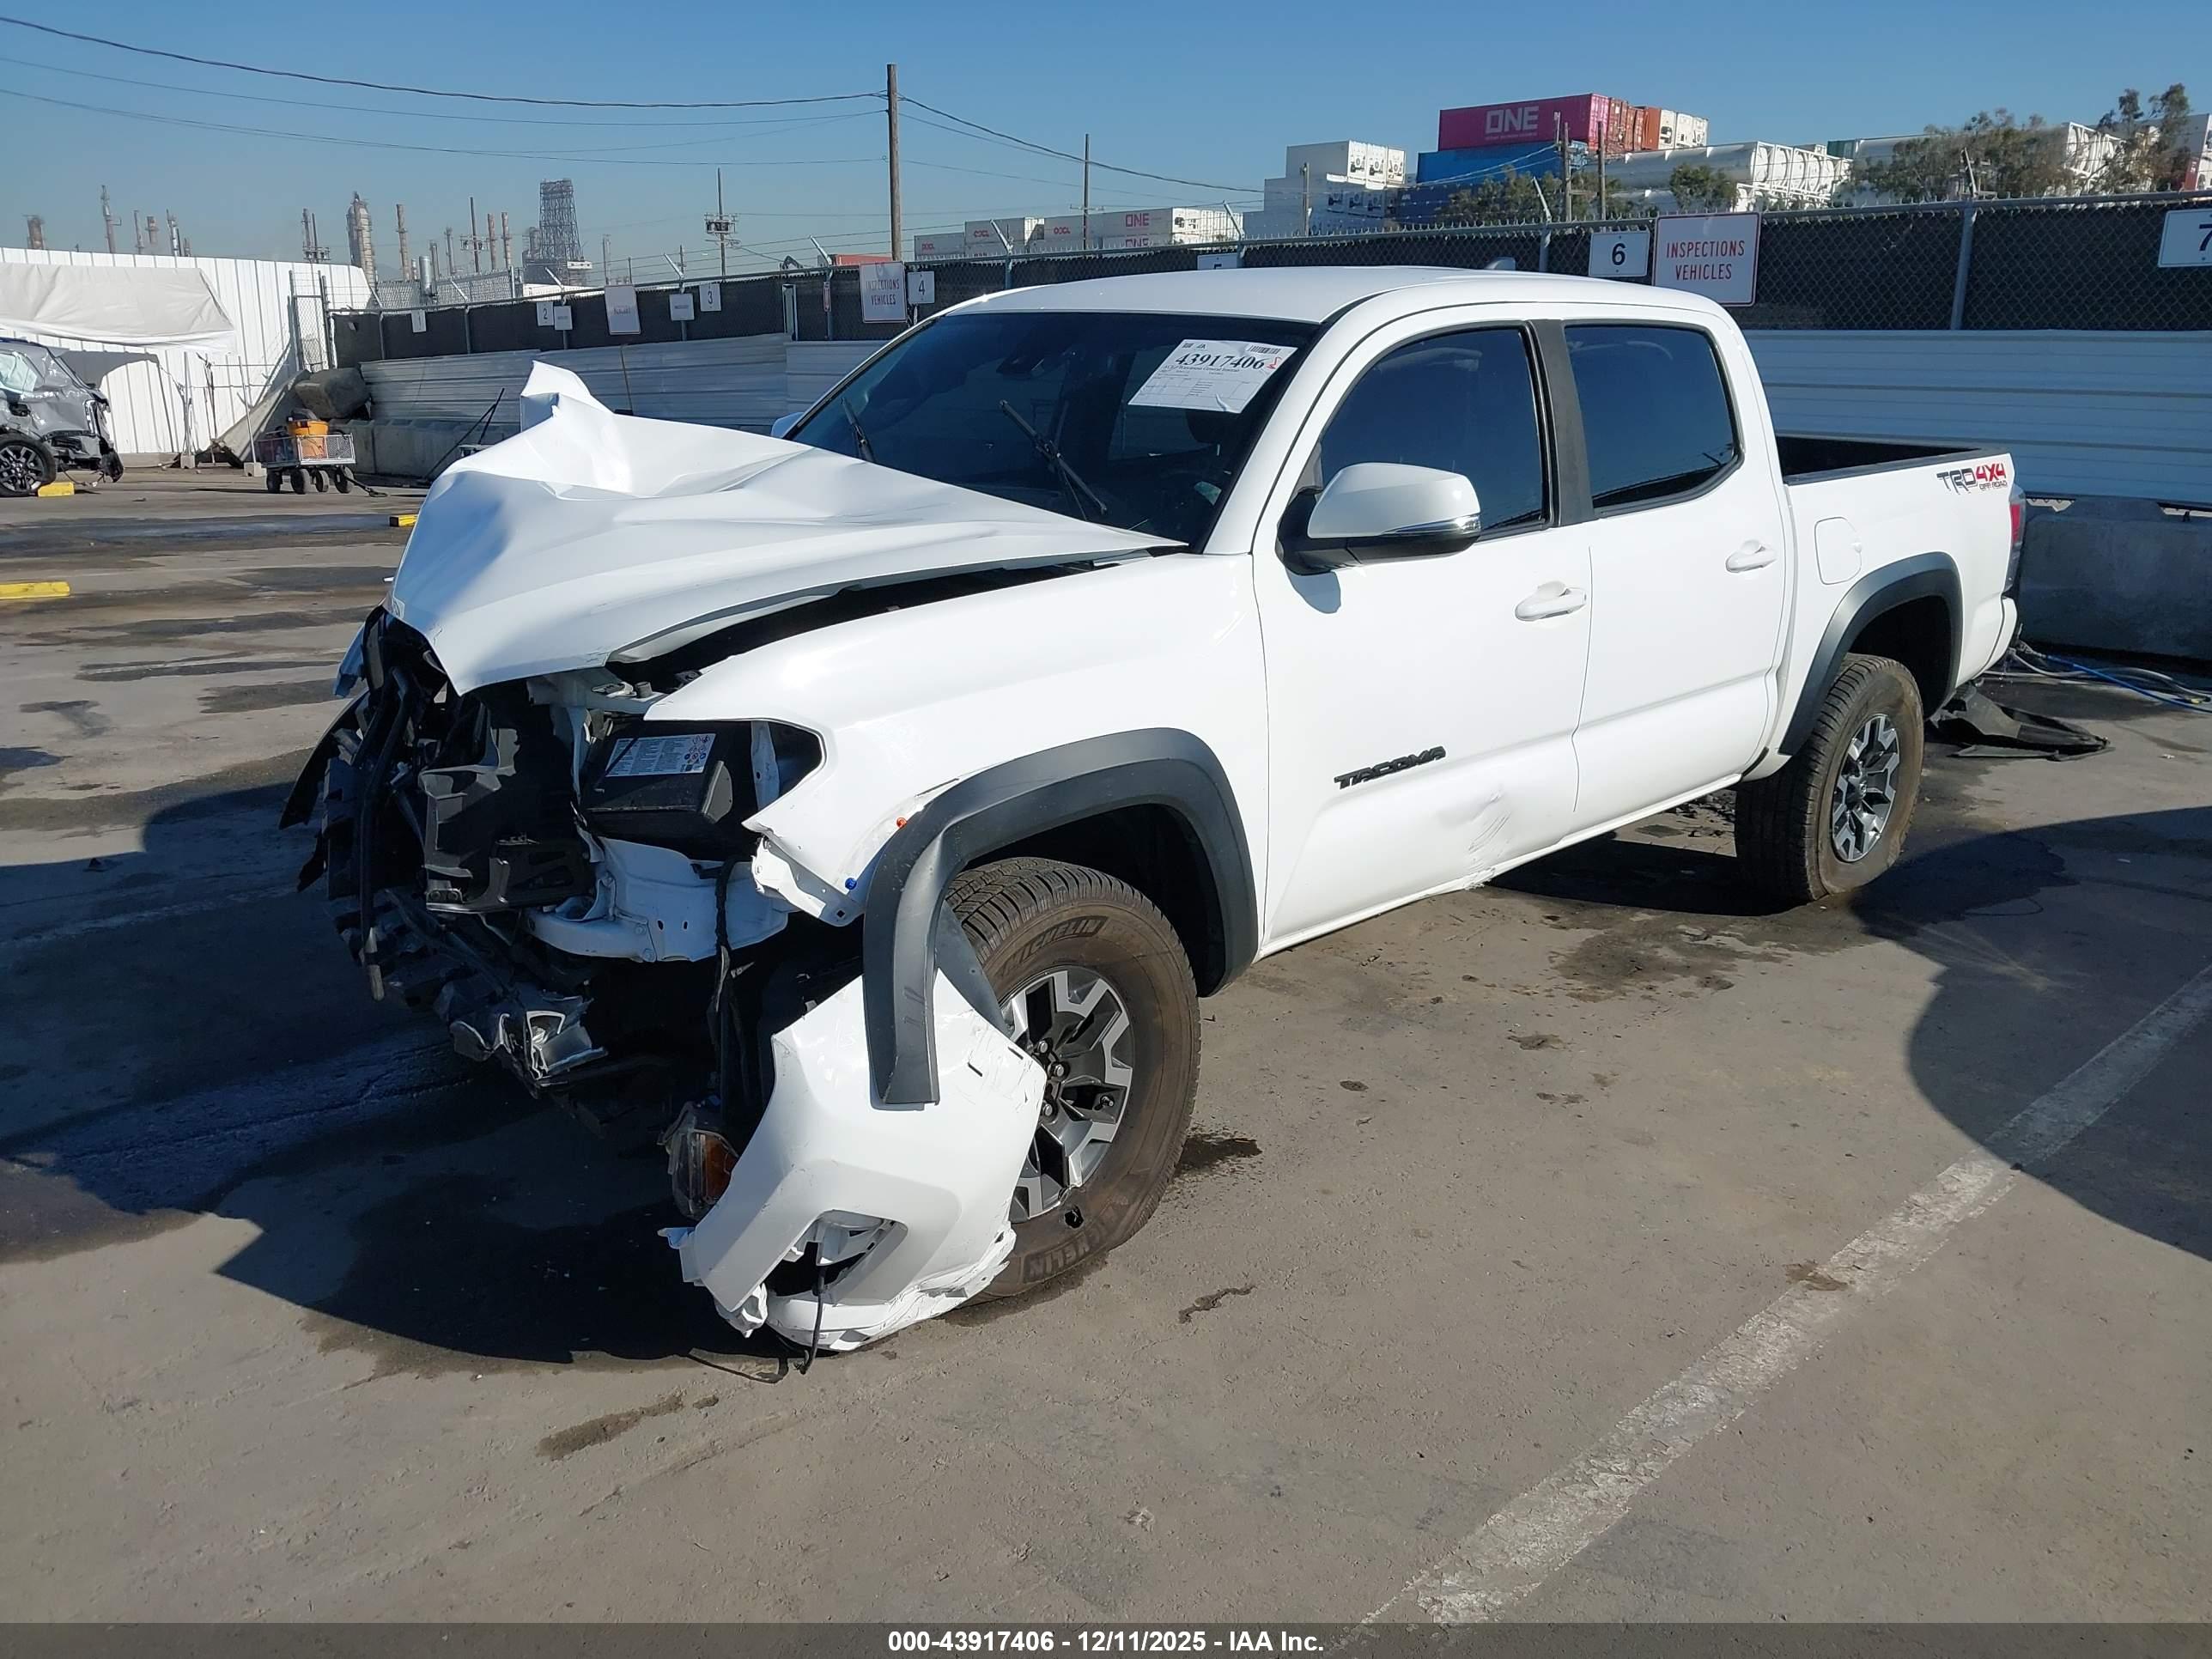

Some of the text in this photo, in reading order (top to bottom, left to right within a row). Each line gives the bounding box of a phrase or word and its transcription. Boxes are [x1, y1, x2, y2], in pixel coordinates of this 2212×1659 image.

[1485, 105, 1540, 134] ONE
[1125, 212, 1150, 228] ONE
[2198, 223, 2212, 252] 7
[1611, 242, 1626, 266] 6
[1666, 240, 1745, 258] INSPECTIONS
[1675, 263, 1732, 281] VEHICLES
[866, 278, 900, 290] INSPECTIONS
[918, 280, 926, 296] 4
[708, 290, 714, 304] 3
[871, 294, 896, 306] VEHICLES
[542, 307, 549, 320] 2
[1175, 353, 1269, 370] 43917406
[1936, 467, 1978, 495] TRD
[1334, 745, 1446, 790] TACOMA
[994, 917, 1103, 977] MICHELIN
